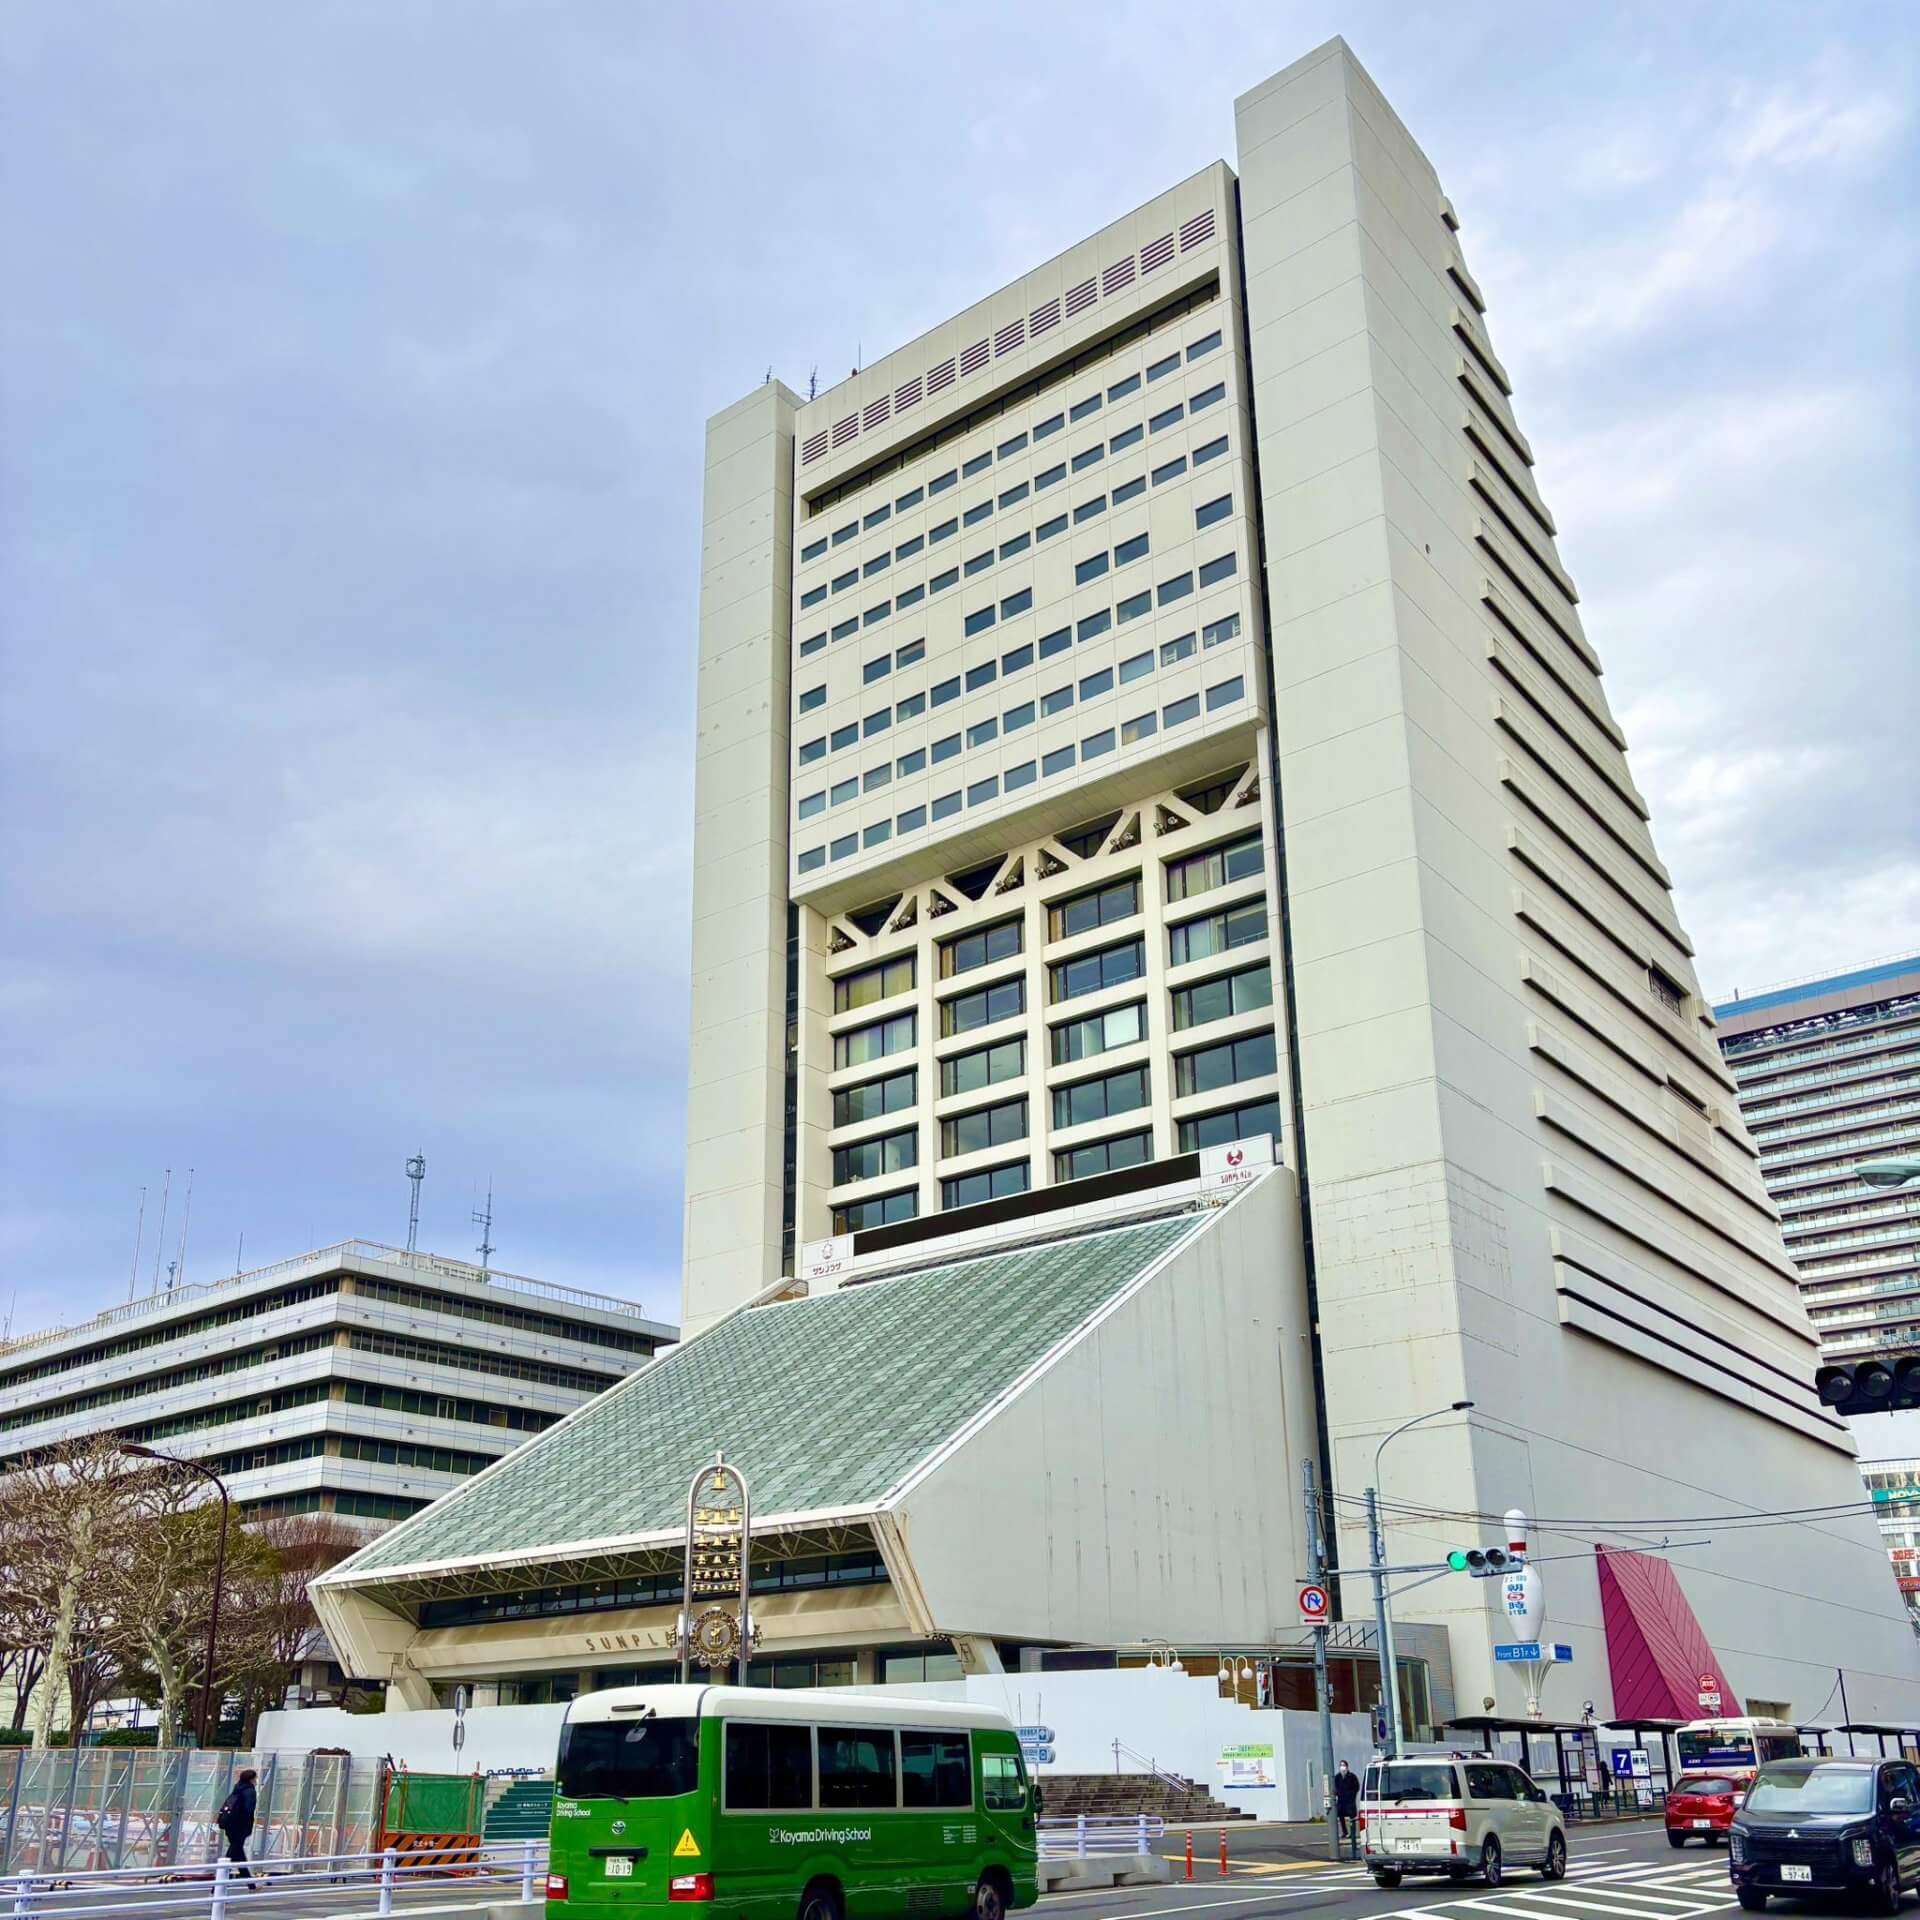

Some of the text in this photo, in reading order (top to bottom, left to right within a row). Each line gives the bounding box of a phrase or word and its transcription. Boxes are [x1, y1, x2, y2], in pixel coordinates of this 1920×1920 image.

[1616, 1753, 1628, 1769] 7
[815, 1827, 845, 1844] Driving
[845, 1826, 871, 1841] School
